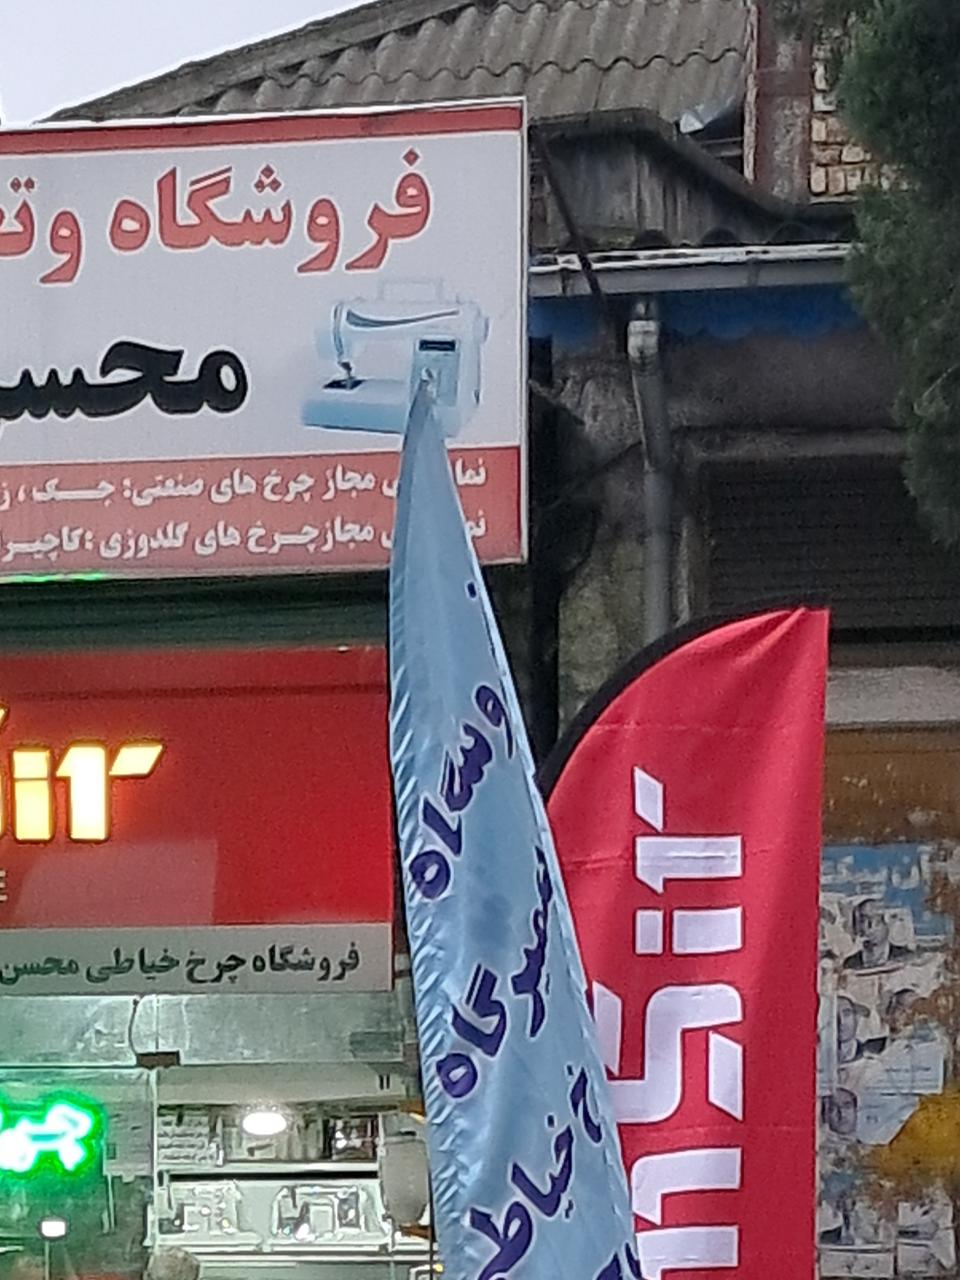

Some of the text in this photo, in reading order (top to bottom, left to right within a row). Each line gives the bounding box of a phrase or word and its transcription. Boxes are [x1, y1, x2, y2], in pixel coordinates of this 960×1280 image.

[110, 148, 432, 273] فروشگاه
[210, 467, 257, 503] های
[263, 468, 315, 502] چرخ
[322, 463, 376, 500] مجاز
[194, 520, 241, 555] های
[85, 947, 180, 984] خیاطی
[185, 950, 247, 985] چرخ
[252, 941, 361, 982] فروشگاه
